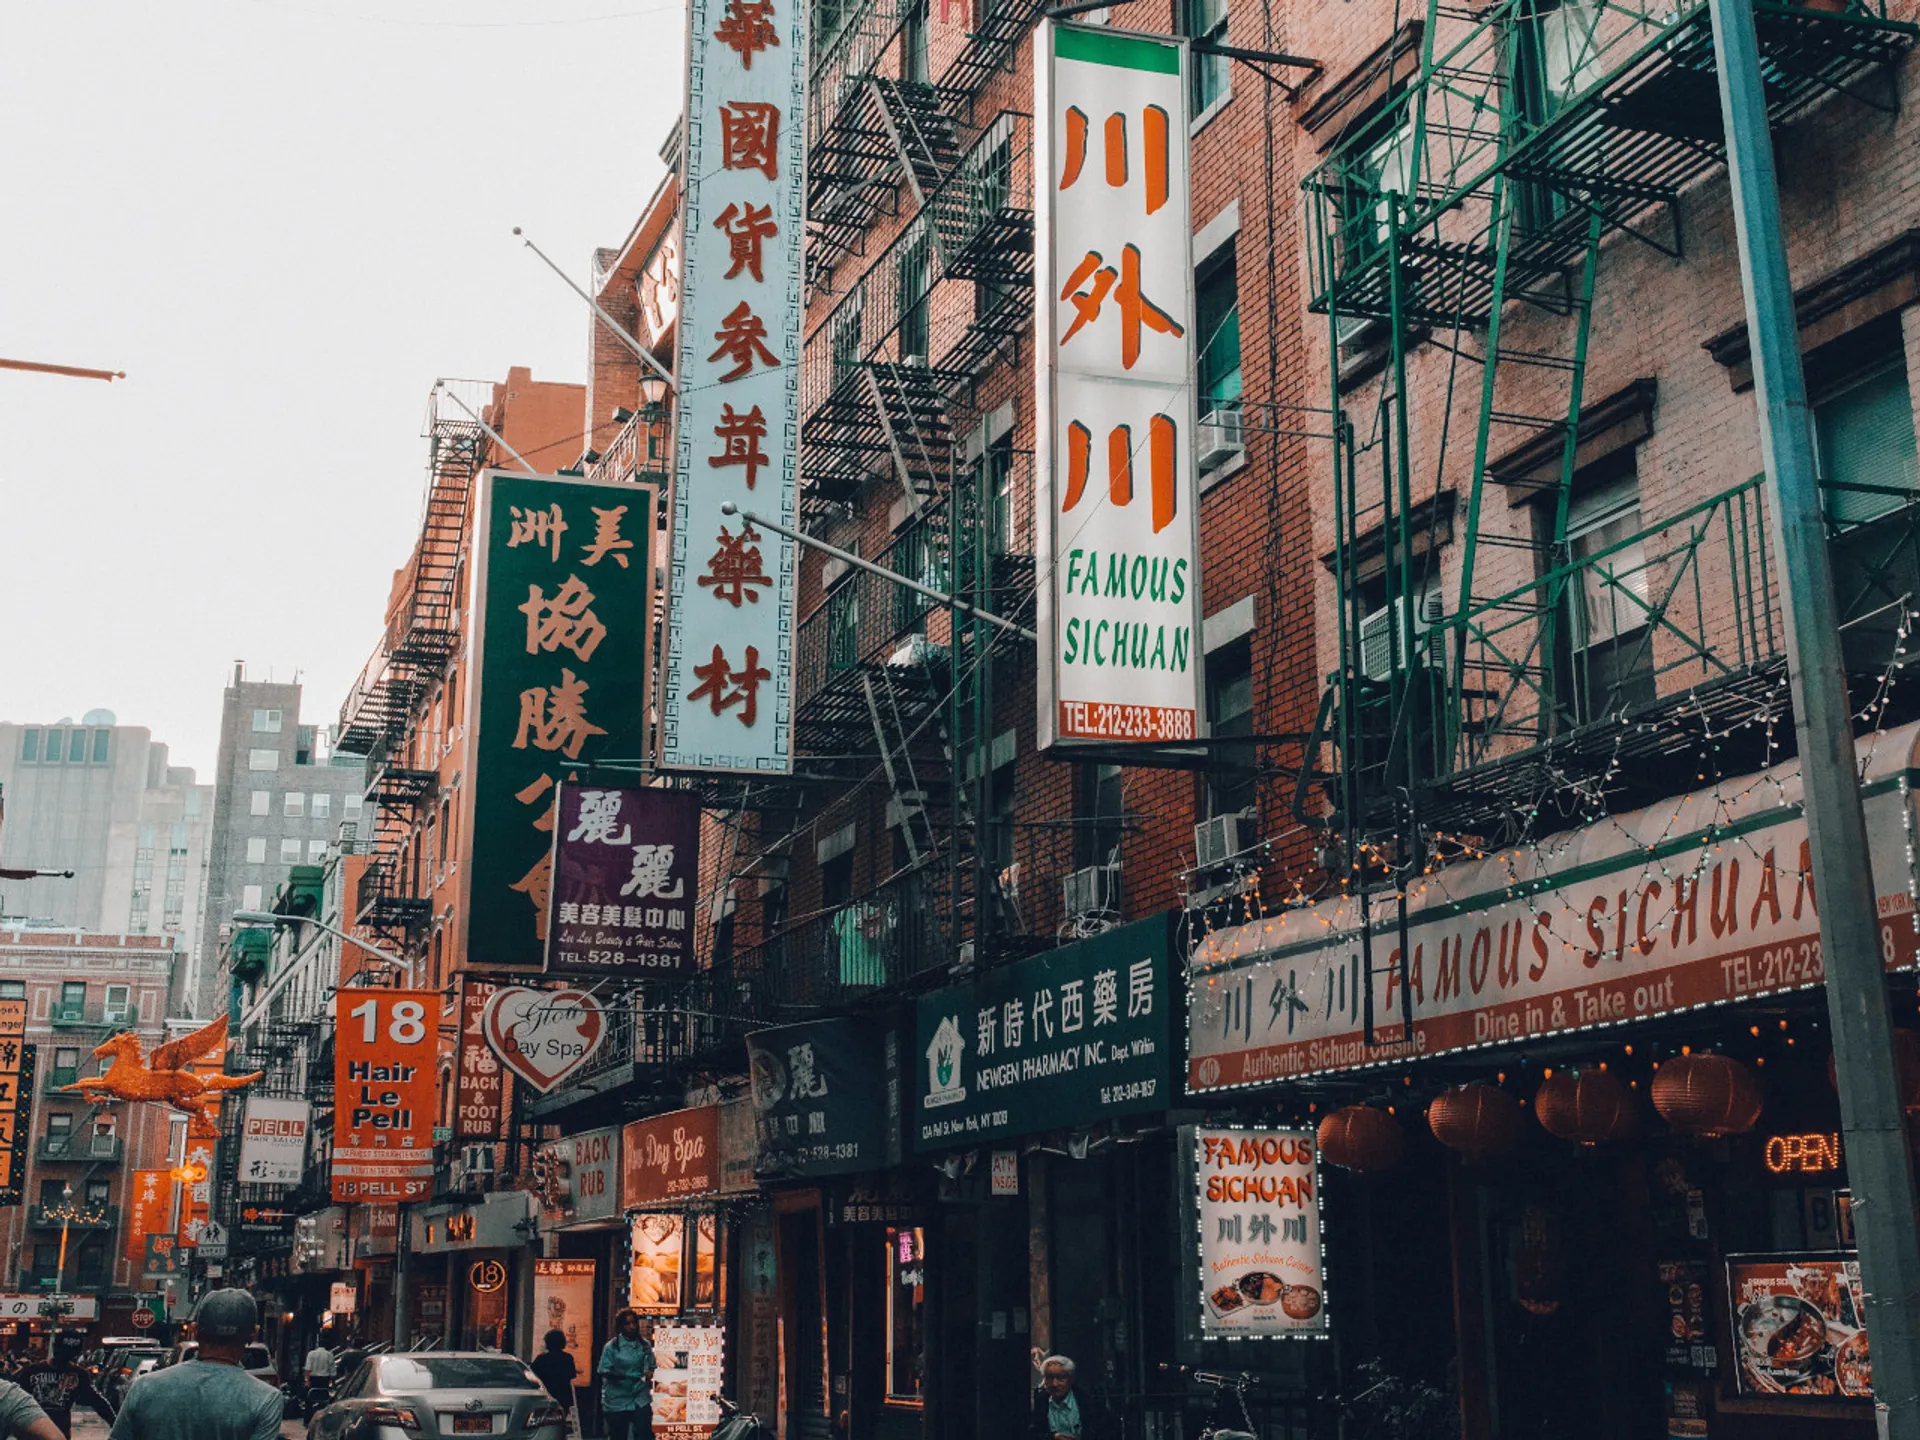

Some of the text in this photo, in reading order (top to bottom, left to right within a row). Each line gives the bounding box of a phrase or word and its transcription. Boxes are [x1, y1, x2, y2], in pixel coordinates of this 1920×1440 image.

[1059, 104, 1185, 534] 川外川
[1066, 549, 1188, 605] FAMOUS
[1063, 617, 1189, 673] SICHUAN
[1064, 702, 1192, 740] TEL:212-233-3888
[1386, 911, 1553, 1012] FAMOUS
[351, 999, 426, 1045] 18
[976, 957, 1155, 1058] 新時代西藥房
[1475, 975, 1675, 1042] Dine in & Take out
[504, 1037, 585, 1060] Day Spa
[977, 1062, 1019, 1092] NEWGEN
[1023, 1046, 1080, 1081] PHARMACY
[1085, 1040, 1107, 1066] INC.
[1242, 1046, 1305, 1079] Authentic
[1309, 1036, 1366, 1069] Sichuan
[348, 1060, 417, 1083] Hair
[460, 1076, 499, 1091] BACK
[360, 1086, 402, 1107] Le
[459, 1105, 499, 1119] FOOT
[474, 1091, 485, 1104] &
[248, 1119, 304, 1136] PELL
[353, 1108, 413, 1131] Pell
[463, 1120, 492, 1134] RUB
[576, 1135, 611, 1167] BACK
[673, 1126, 706, 1173] Spa
[1203, 1136, 1314, 1171] FAMOUS
[1765, 1132, 1839, 1173] OPEN
[360, 1181, 401, 1196] PELL
[405, 1180, 428, 1194] ST
[581, 1170, 604, 1198] RUB
[1206, 1171, 1313, 1208] SICHUAN
[1217, 1213, 1307, 1245] 川外川
